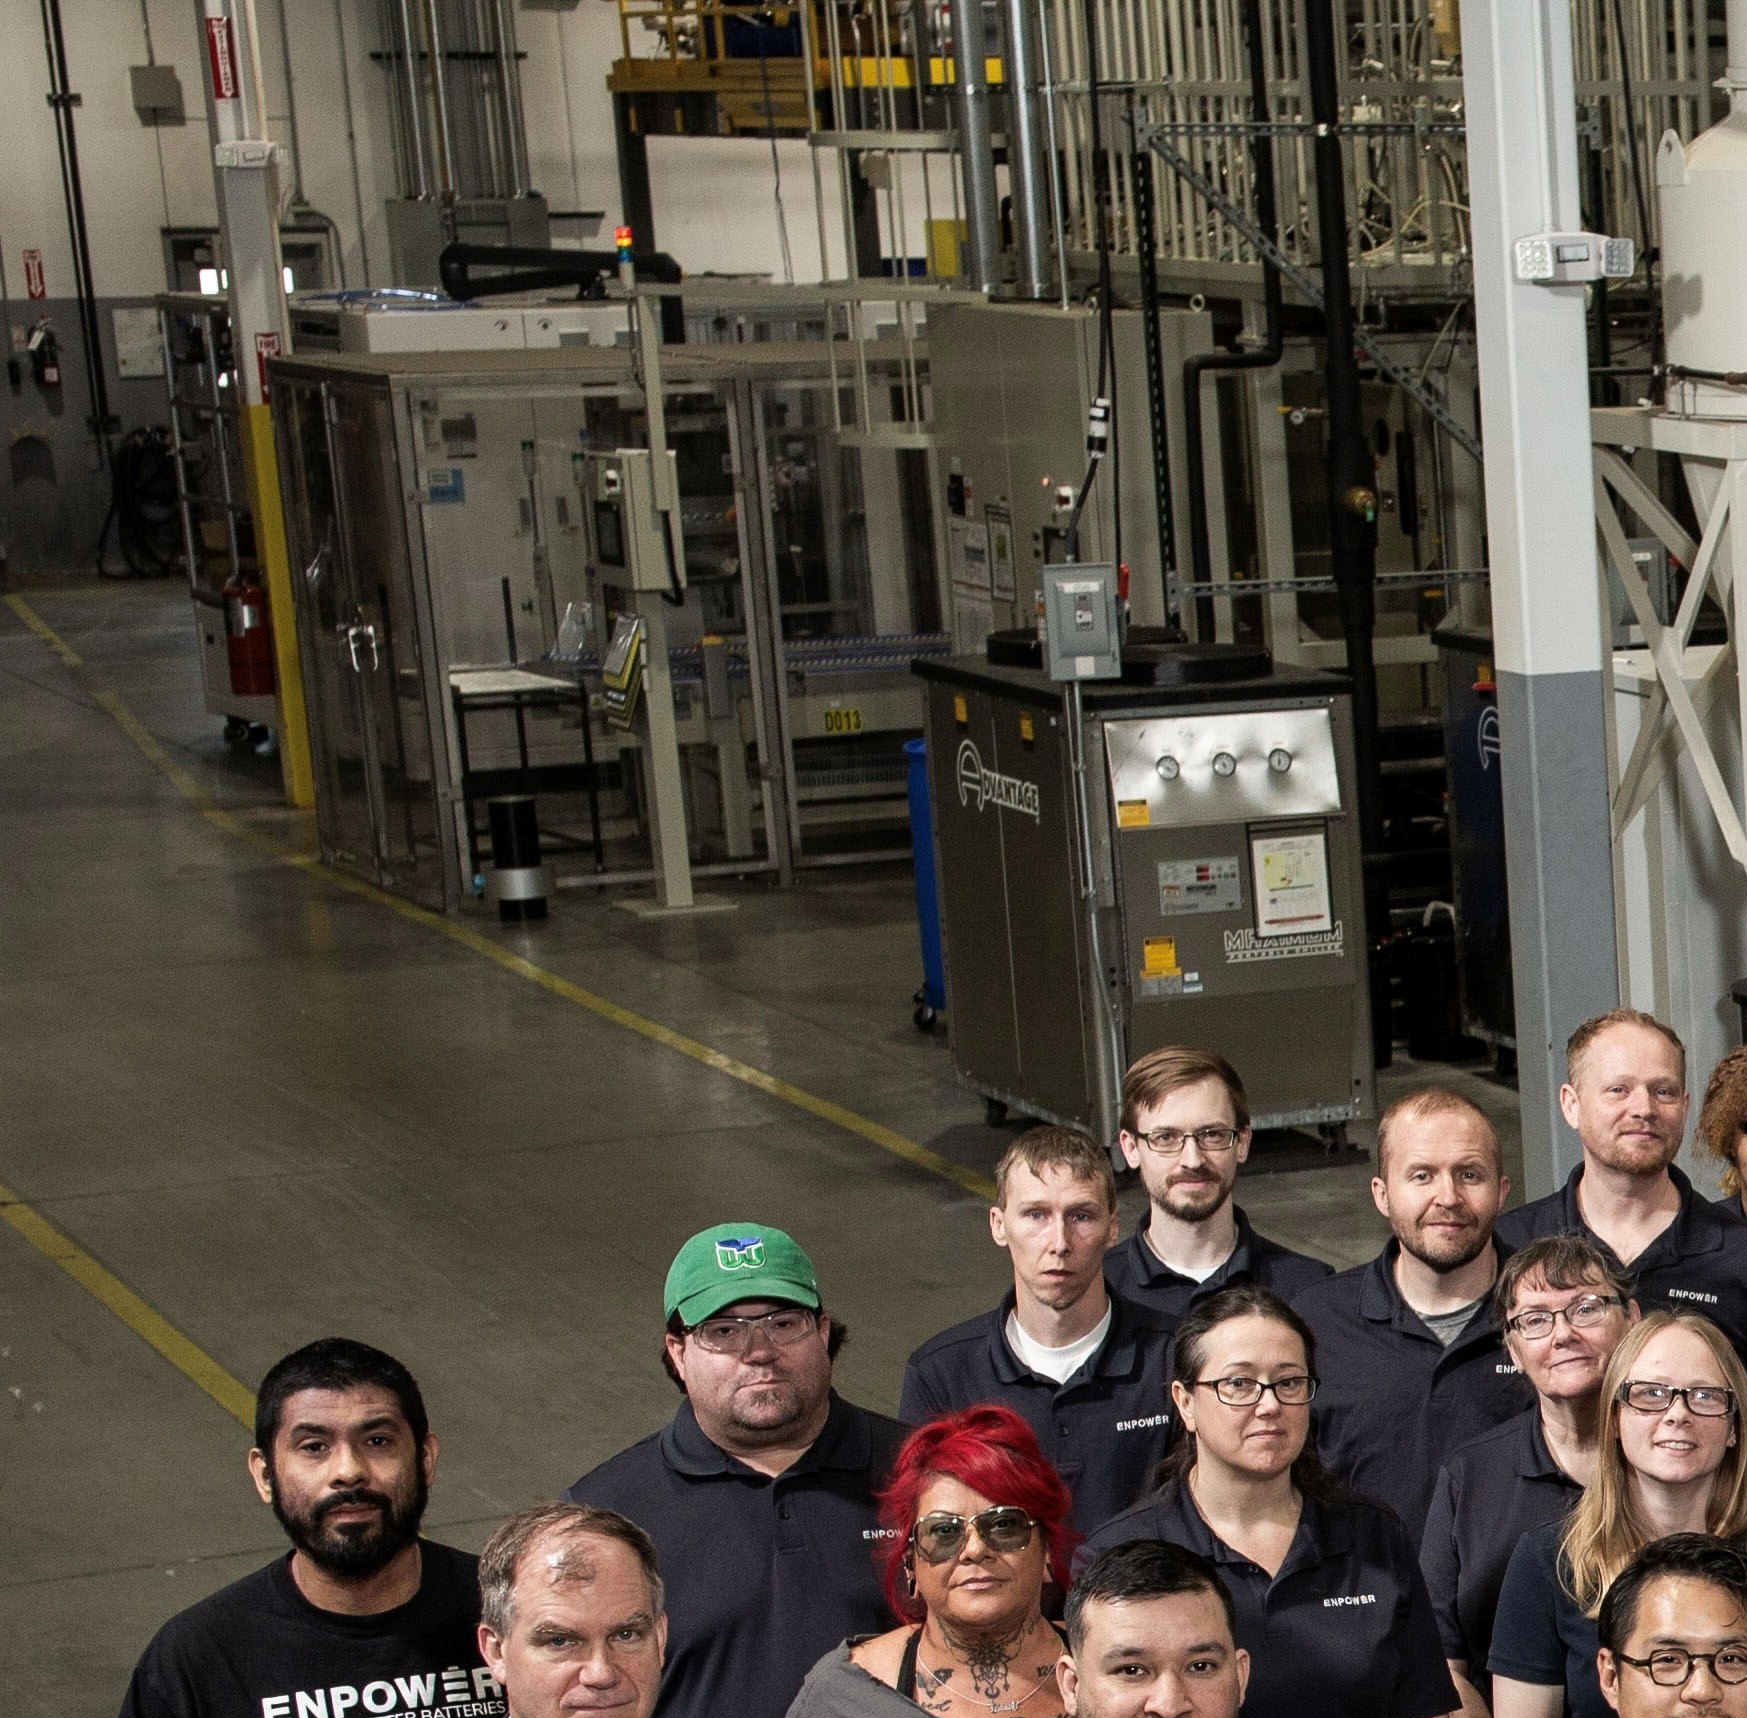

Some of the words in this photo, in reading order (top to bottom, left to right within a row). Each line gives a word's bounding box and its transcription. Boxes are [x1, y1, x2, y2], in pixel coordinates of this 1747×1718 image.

[1668, 1288, 1718, 1304] ENPOWER
[1116, 1415, 1169, 1431] ENPOWER
[863, 1530, 903, 1539] ENPOW
[1323, 1594, 1376, 1607] ENPOWER
